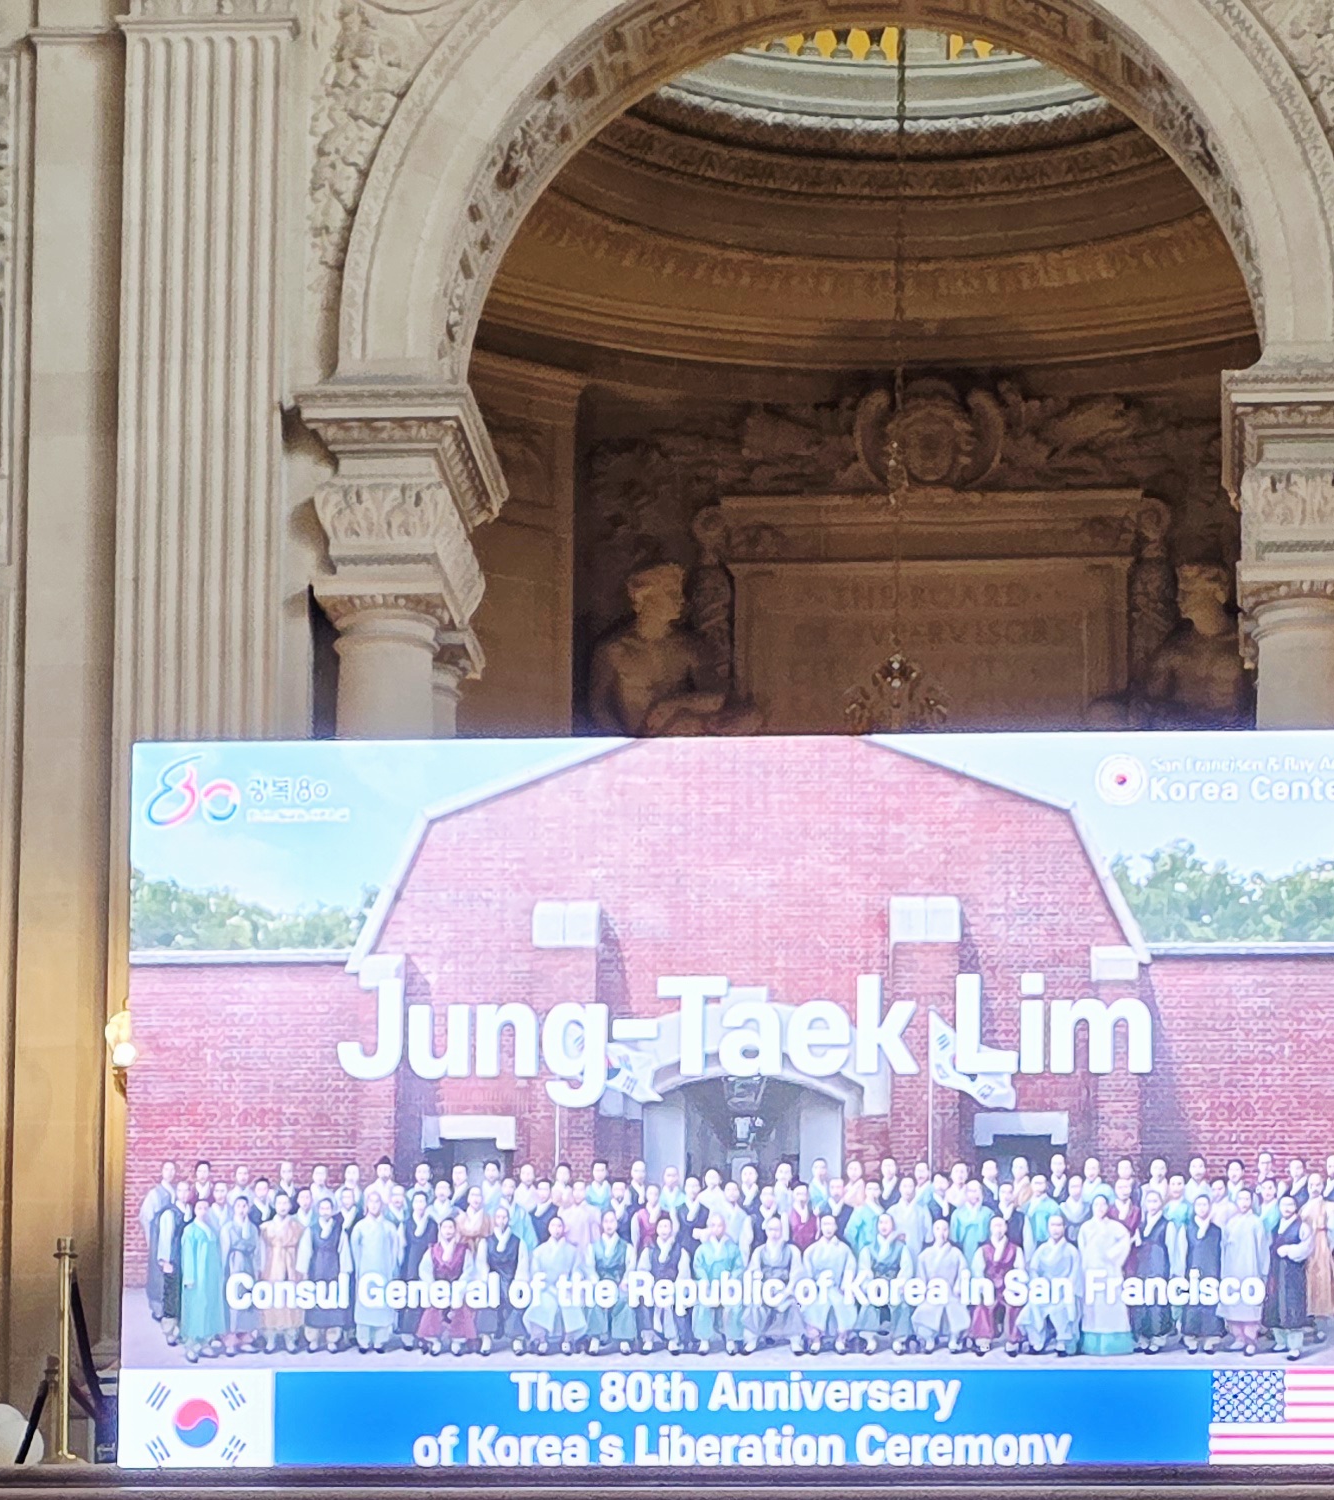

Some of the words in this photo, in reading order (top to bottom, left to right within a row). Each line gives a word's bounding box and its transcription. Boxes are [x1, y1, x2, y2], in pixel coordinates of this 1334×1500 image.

[1150, 777, 1239, 801] Korea
[336, 973, 920, 1107] Jung-Taek
[956, 972, 1153, 1074] Lim
[225, 1273, 349, 1310] Consul
[359, 1272, 500, 1310] General
[509, 1272, 549, 1309] of
[556, 1272, 616, 1309] the
[628, 1270, 785, 1317] Republic
[795, 1270, 835, 1307] of
[843, 1271, 949, 1307] Korea
[960, 1270, 994, 1306] in
[1002, 1270, 1070, 1306] San
[1085, 1269, 1266, 1307] Francisco
[510, 1371, 589, 1412] The
[599, 1371, 698, 1412] 80th
[706, 1371, 960, 1422] Anniversary
[413, 1424, 459, 1467] of
[635, 1424, 845, 1467] Liberation
[855, 1423, 1072, 1467] Ceremony
